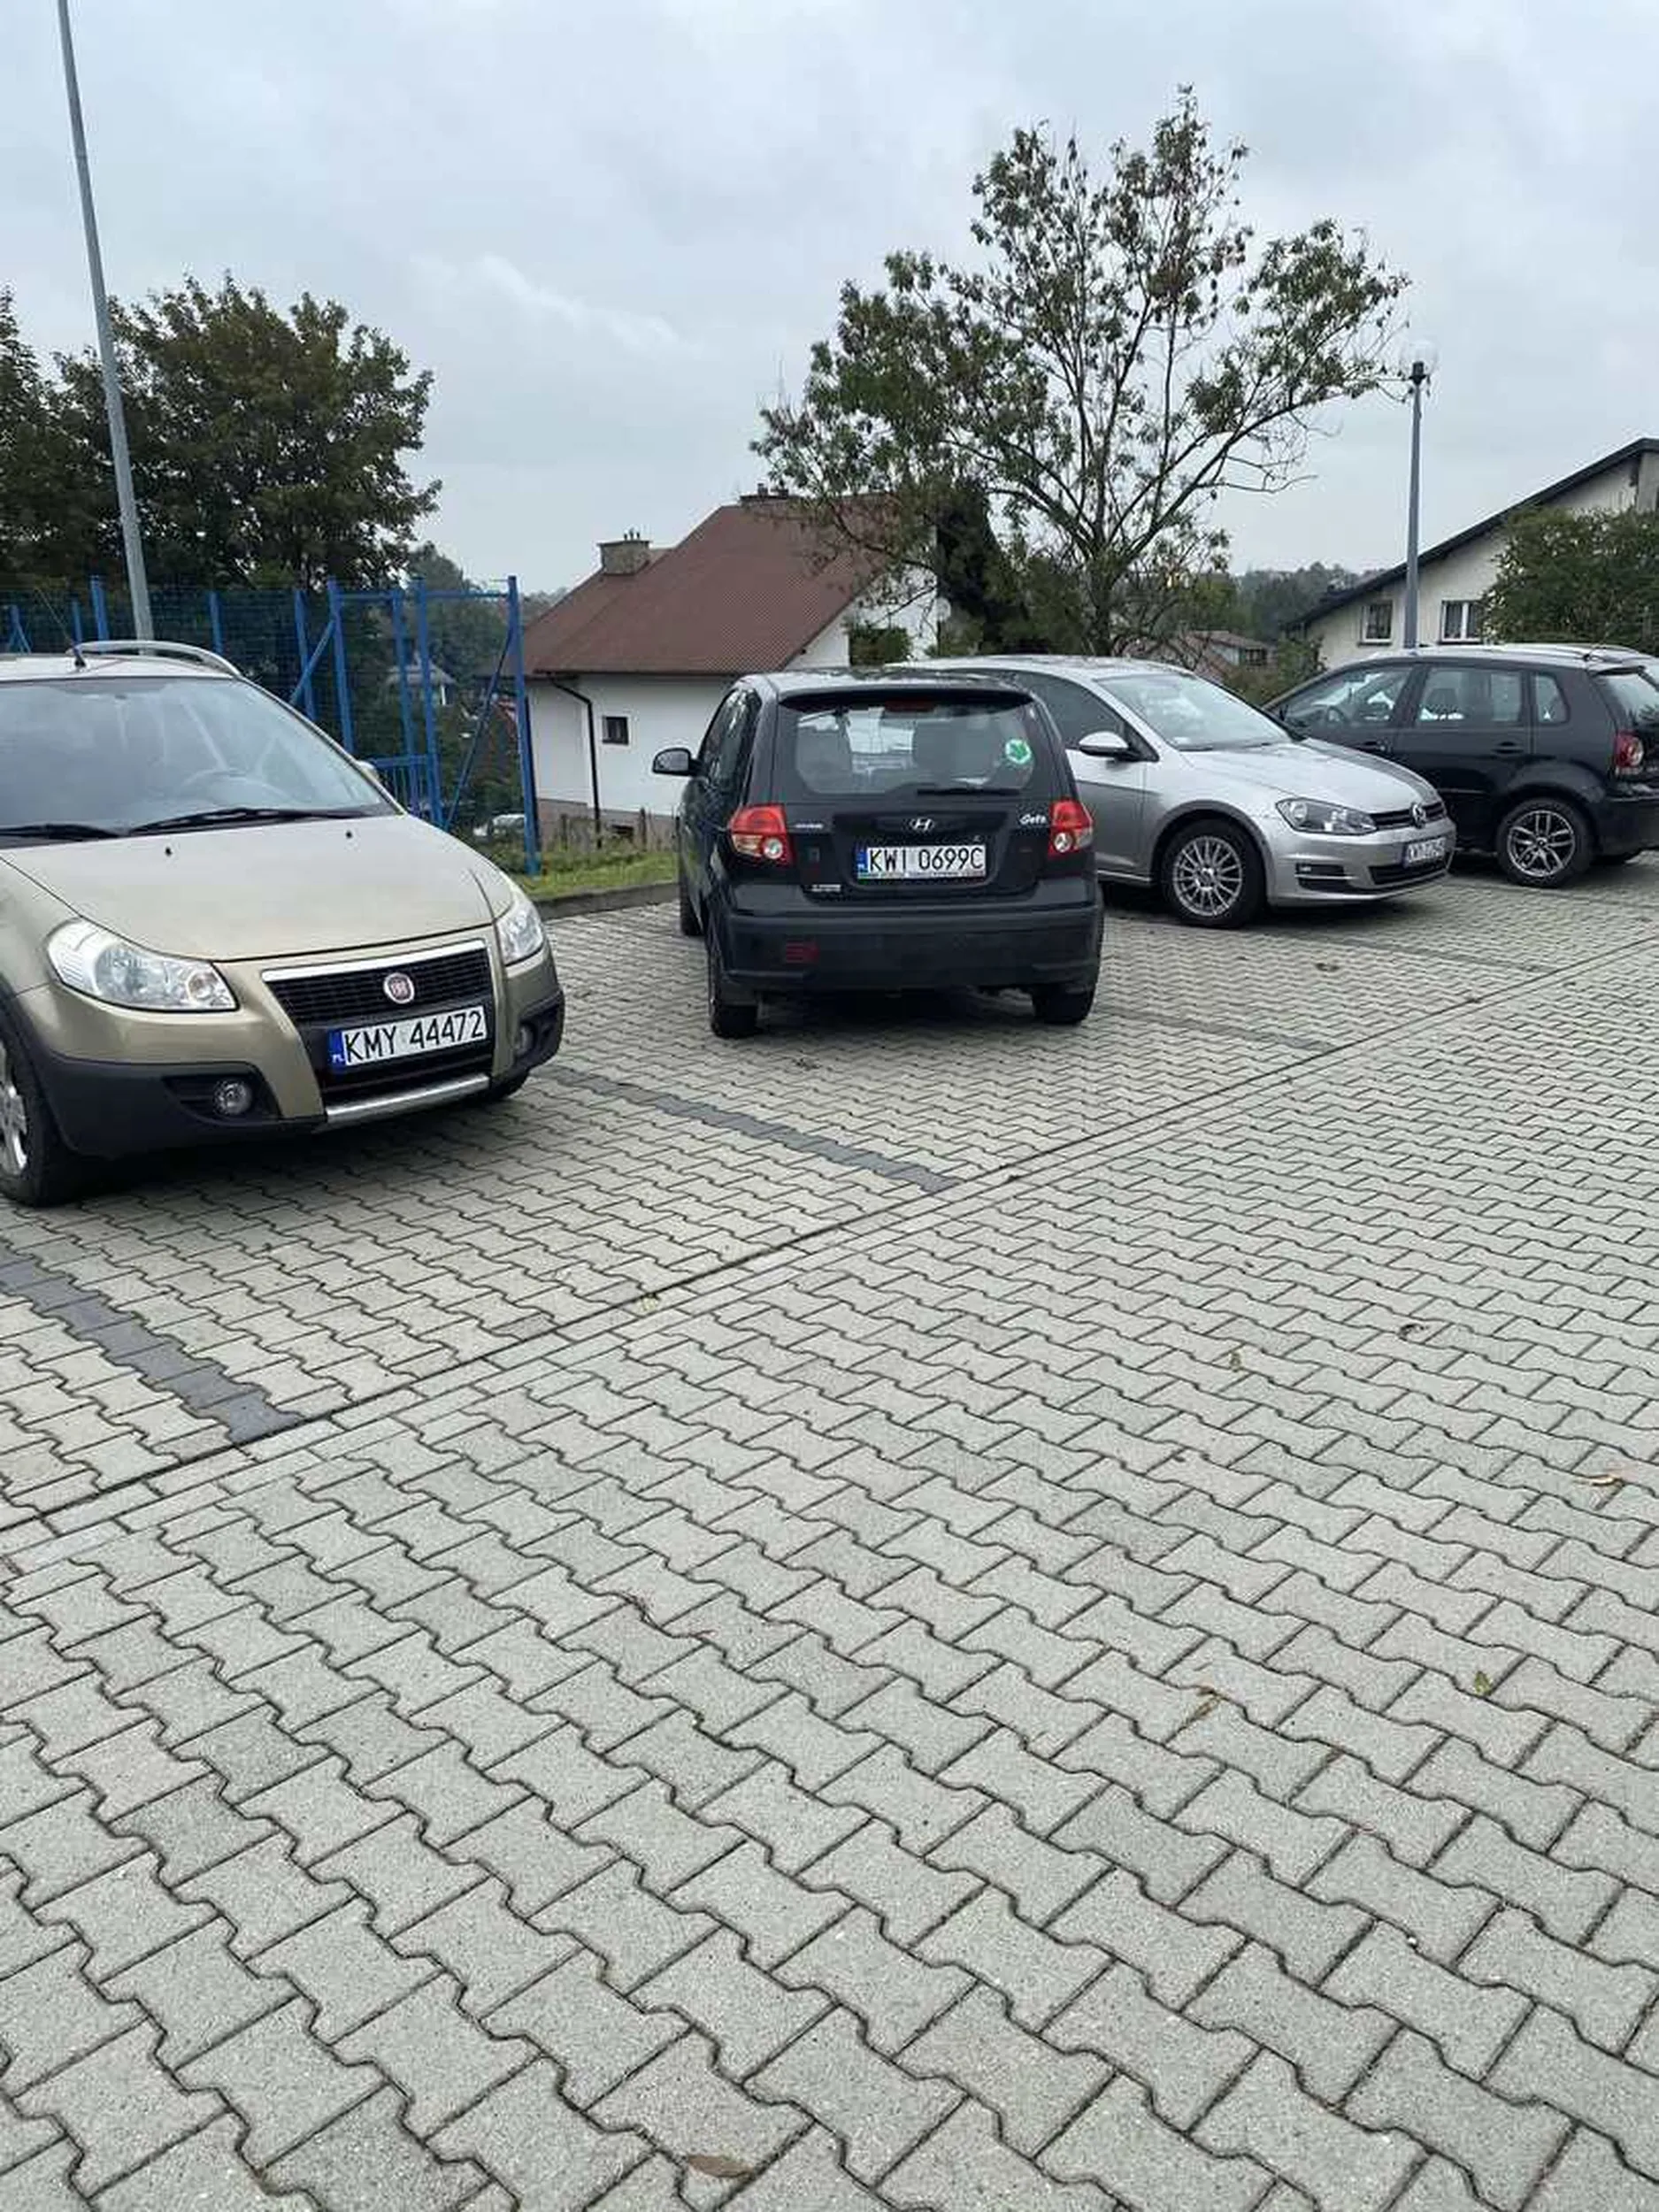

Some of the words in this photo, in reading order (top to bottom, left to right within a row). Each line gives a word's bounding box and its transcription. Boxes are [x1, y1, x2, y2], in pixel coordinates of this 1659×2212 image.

[869, 849, 906, 872] KWI
[918, 847, 983, 871] 0699C
[344, 1025, 396, 1064] KMY
[410, 1010, 484, 1049] 44472
